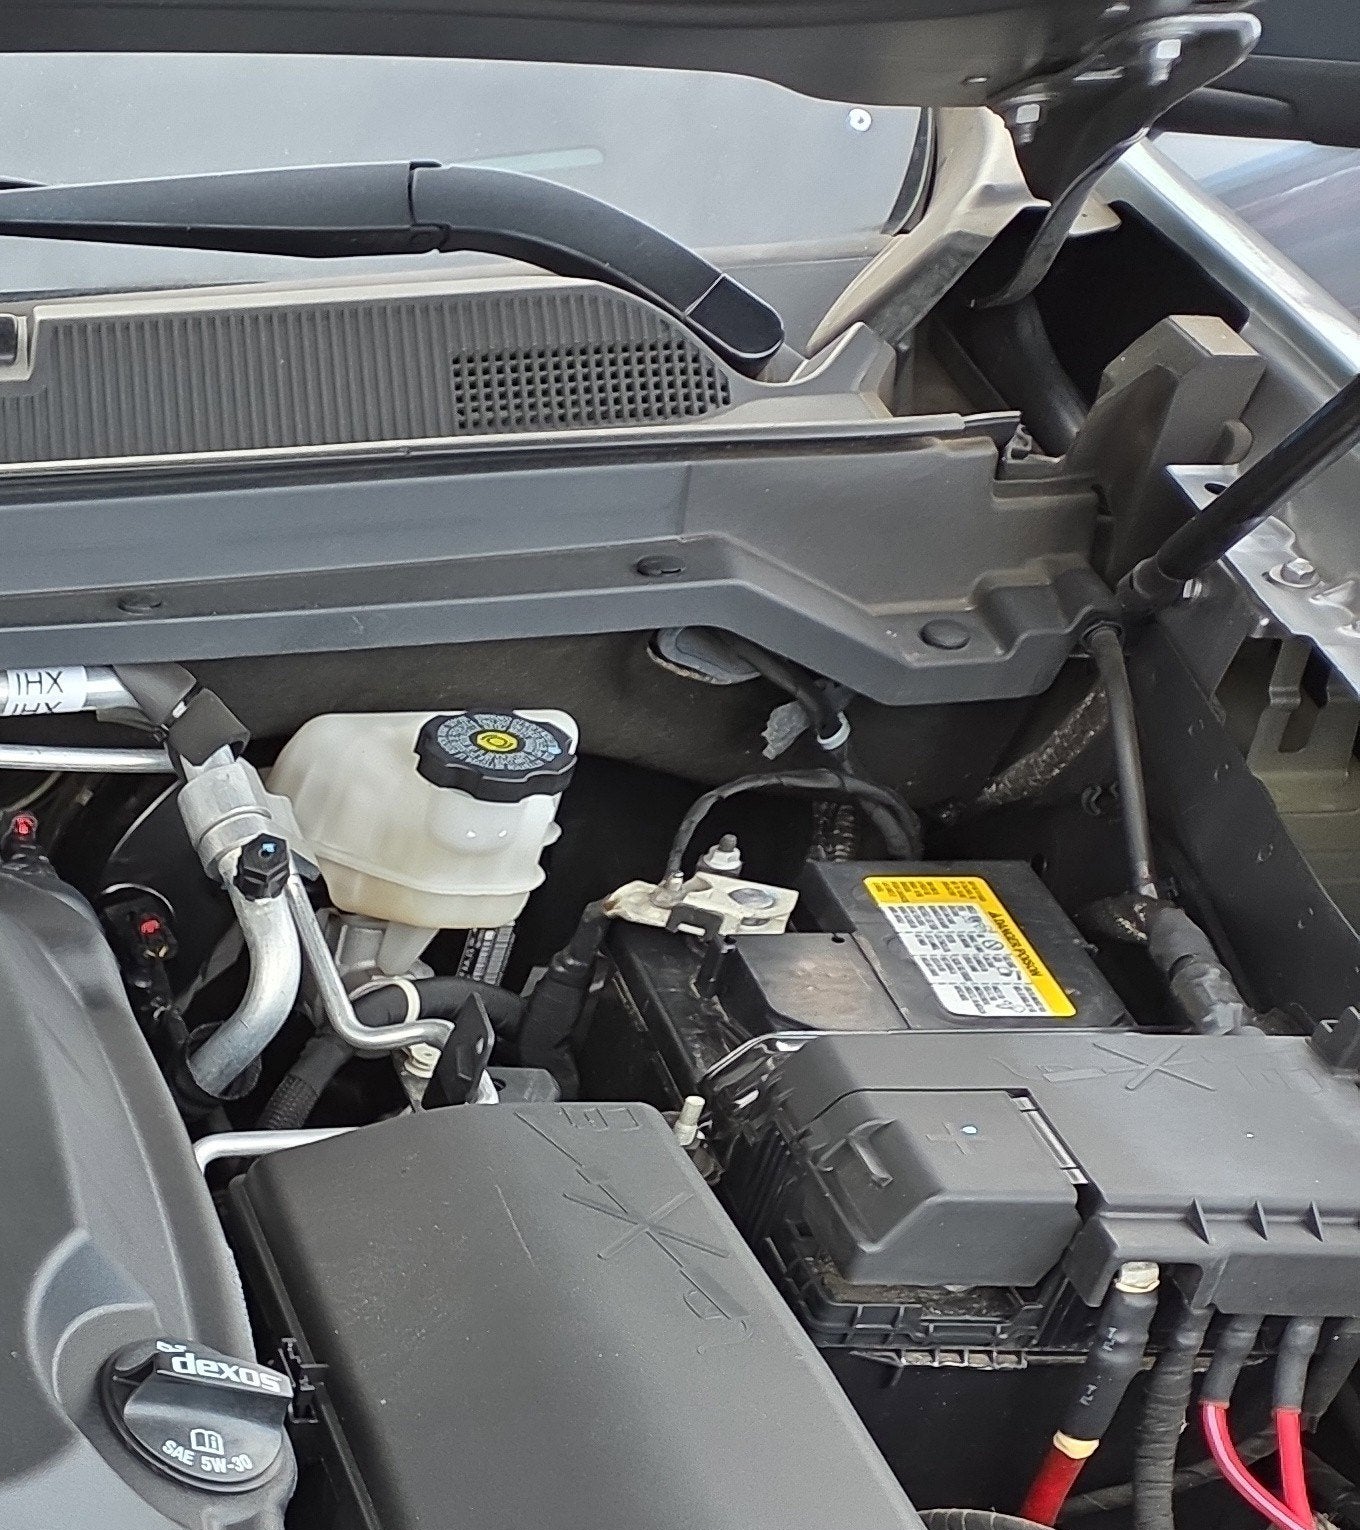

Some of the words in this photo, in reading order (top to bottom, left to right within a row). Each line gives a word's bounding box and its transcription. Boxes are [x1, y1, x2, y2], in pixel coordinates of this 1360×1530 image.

[15, 670, 64, 696] IHX
[171, 1352, 283, 1393] dexos
[162, 1440, 195, 1466] SAE
[201, 1453, 253, 1474] 5W-30
